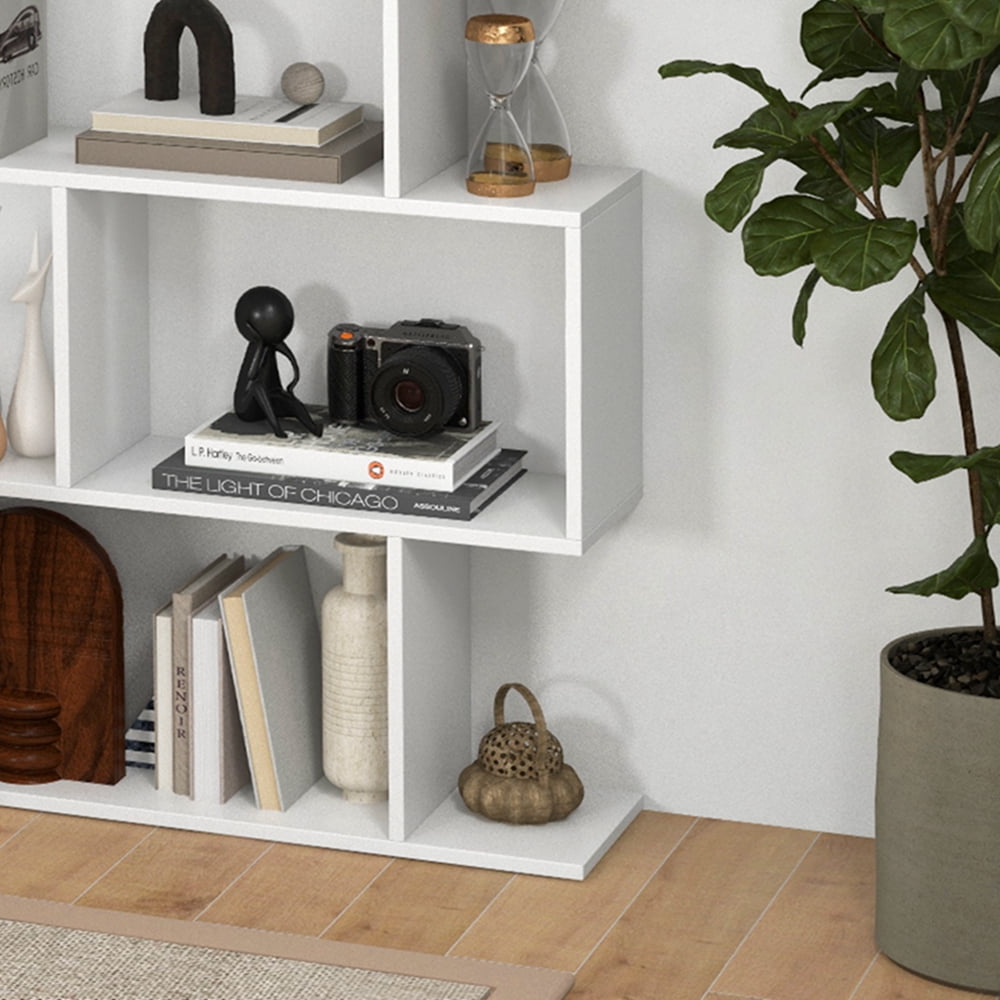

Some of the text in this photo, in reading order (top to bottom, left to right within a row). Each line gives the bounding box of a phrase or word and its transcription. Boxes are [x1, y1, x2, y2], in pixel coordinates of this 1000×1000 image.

[161, 472, 399, 511] THE LIGHT OF CHICAGO
[413, 502, 461, 514] ASSOULINE
[175, 666, 188, 739] RENOIR
